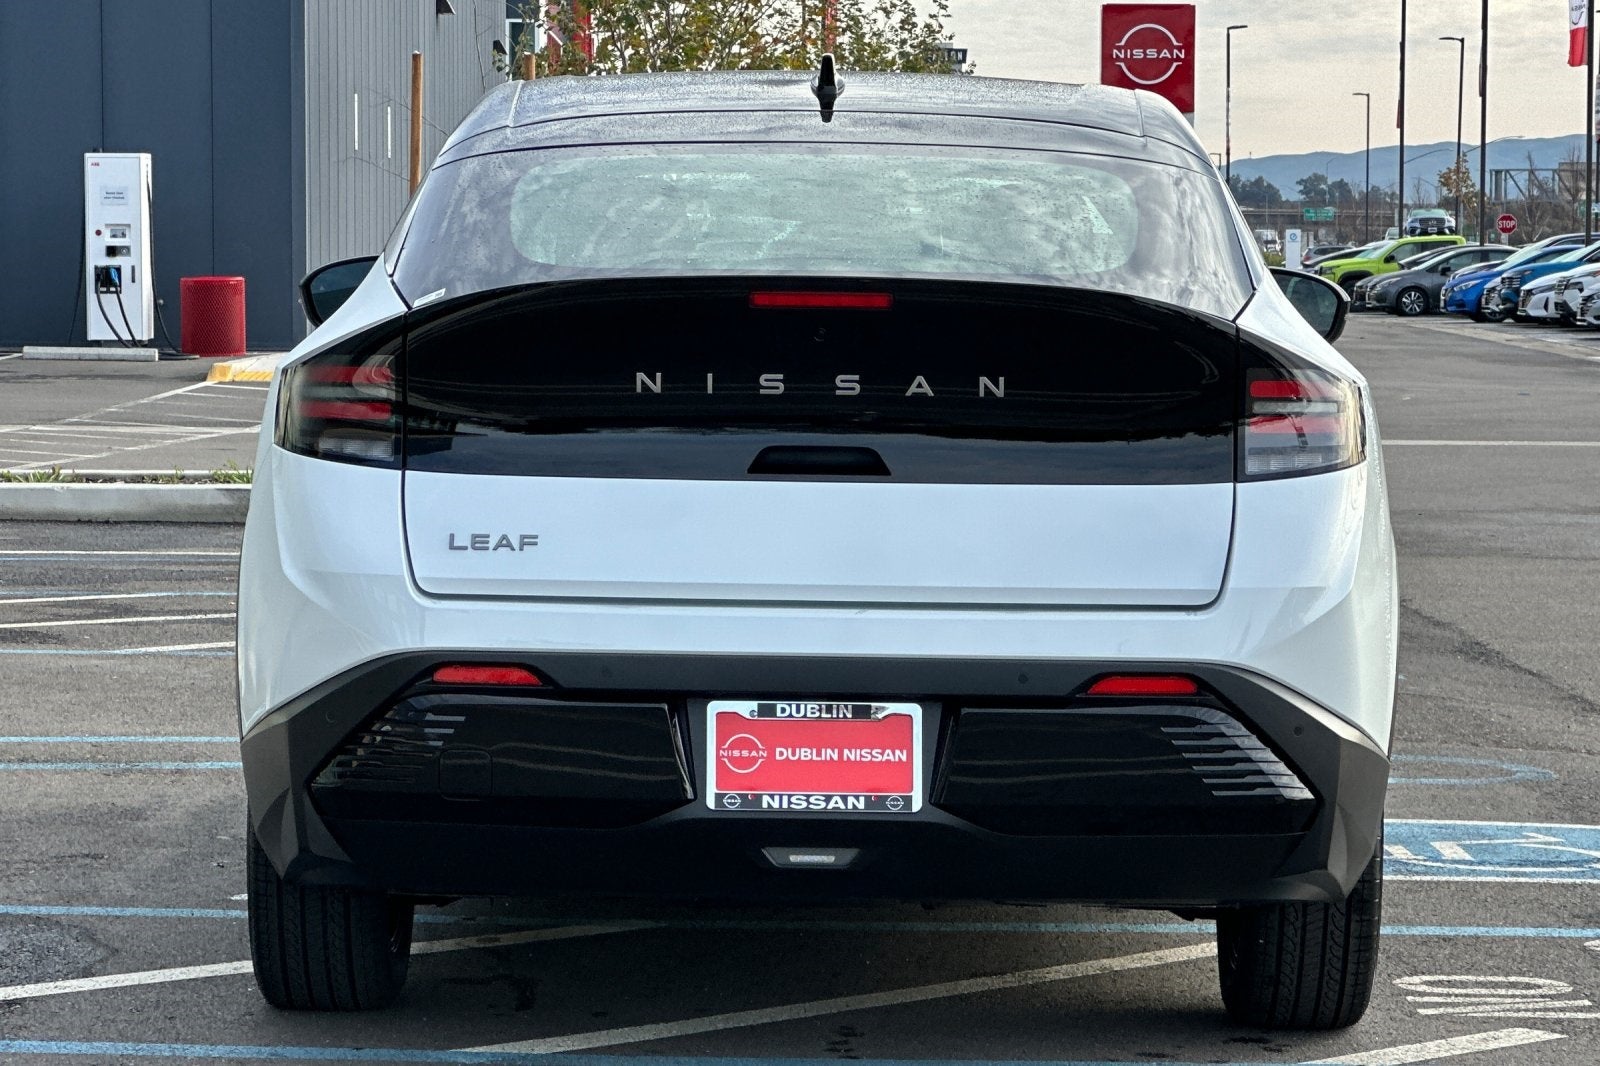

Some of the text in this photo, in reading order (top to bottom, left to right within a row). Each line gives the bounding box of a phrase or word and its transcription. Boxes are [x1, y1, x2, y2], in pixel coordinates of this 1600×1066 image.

[1112, 48, 1185, 59] NISSAN
[1498, 220, 1516, 229] STOP
[636, 372, 1005, 398] NISSAN
[448, 532, 539, 552] LEAF
[776, 703, 853, 719] DUBLIN
[719, 749, 768, 758] NISSAN
[775, 747, 907, 762] DUBLIN NISSAN
[761, 794, 865, 810] NISSAN
